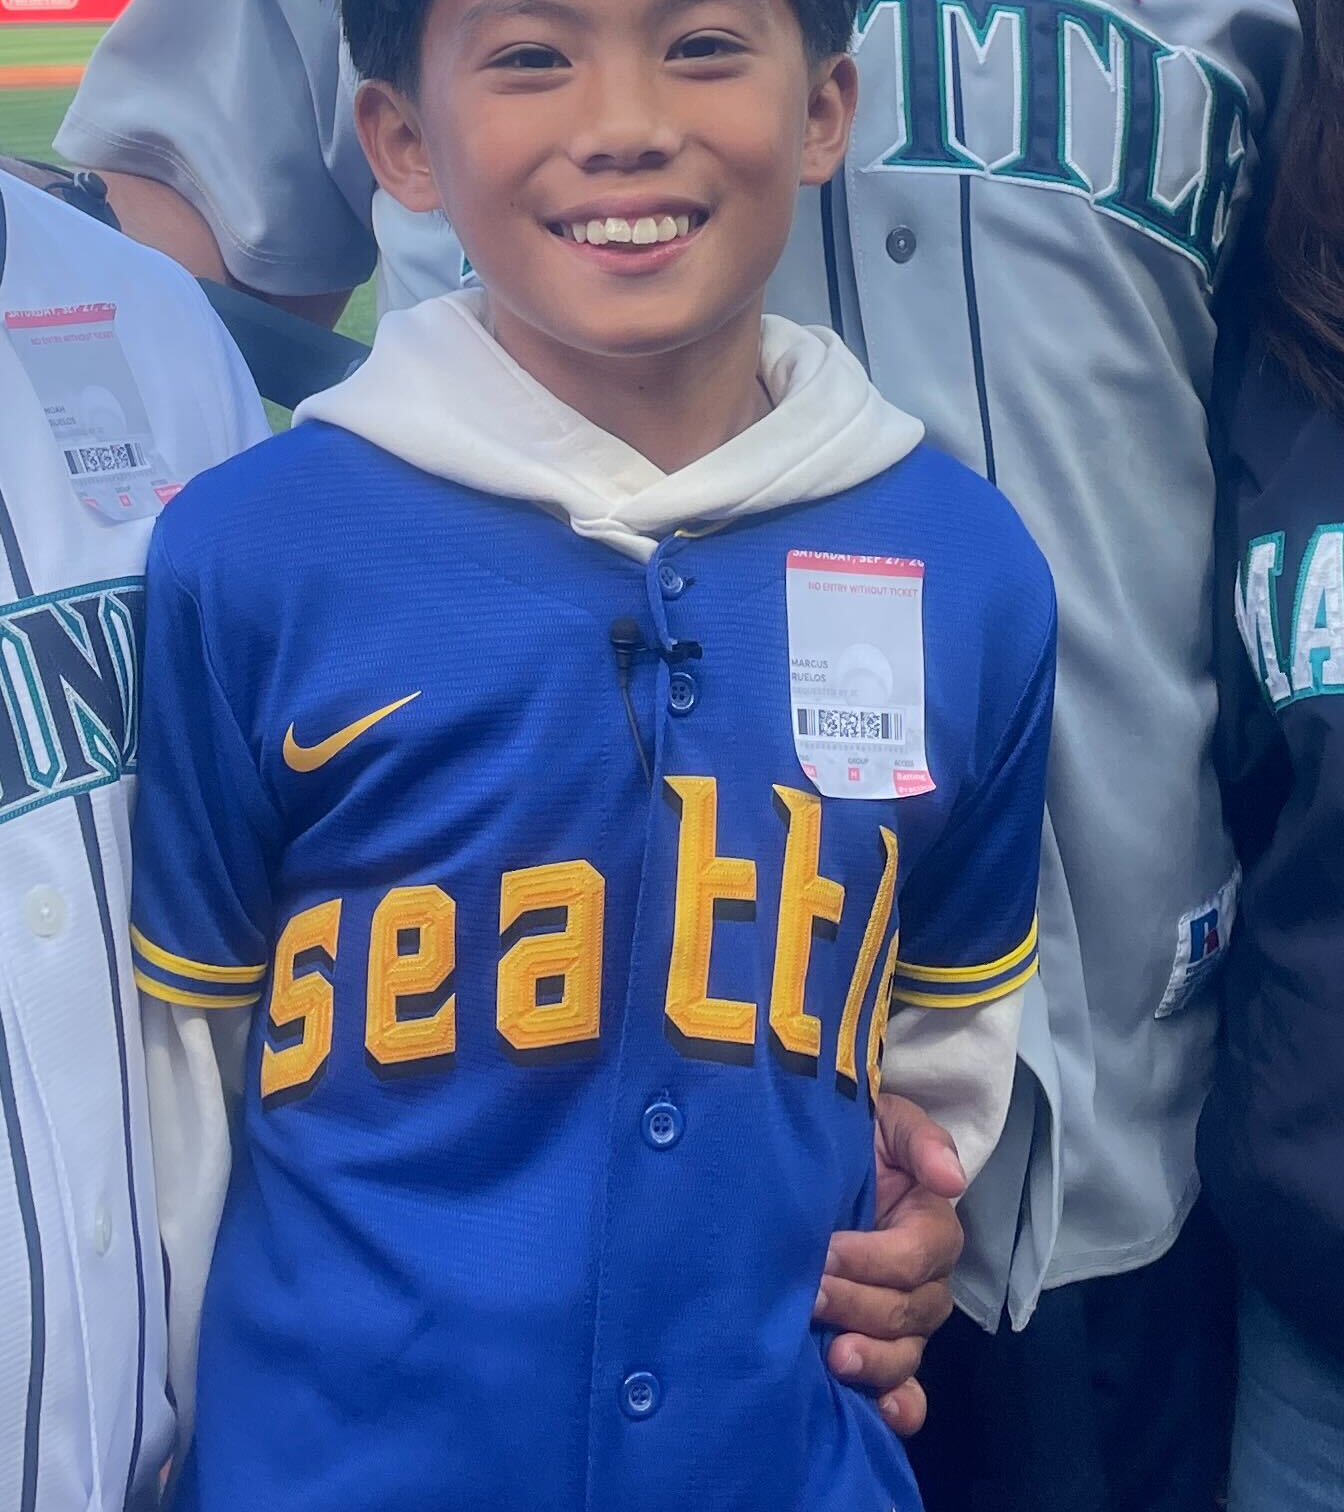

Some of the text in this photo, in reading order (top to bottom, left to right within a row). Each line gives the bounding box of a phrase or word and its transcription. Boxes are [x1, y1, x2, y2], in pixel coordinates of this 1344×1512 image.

[808, 581, 821, 591] NO
[791, 658, 828, 669] MARCUS
[791, 672, 827, 682] RUELOS
[261, 774, 899, 1106] seattl
